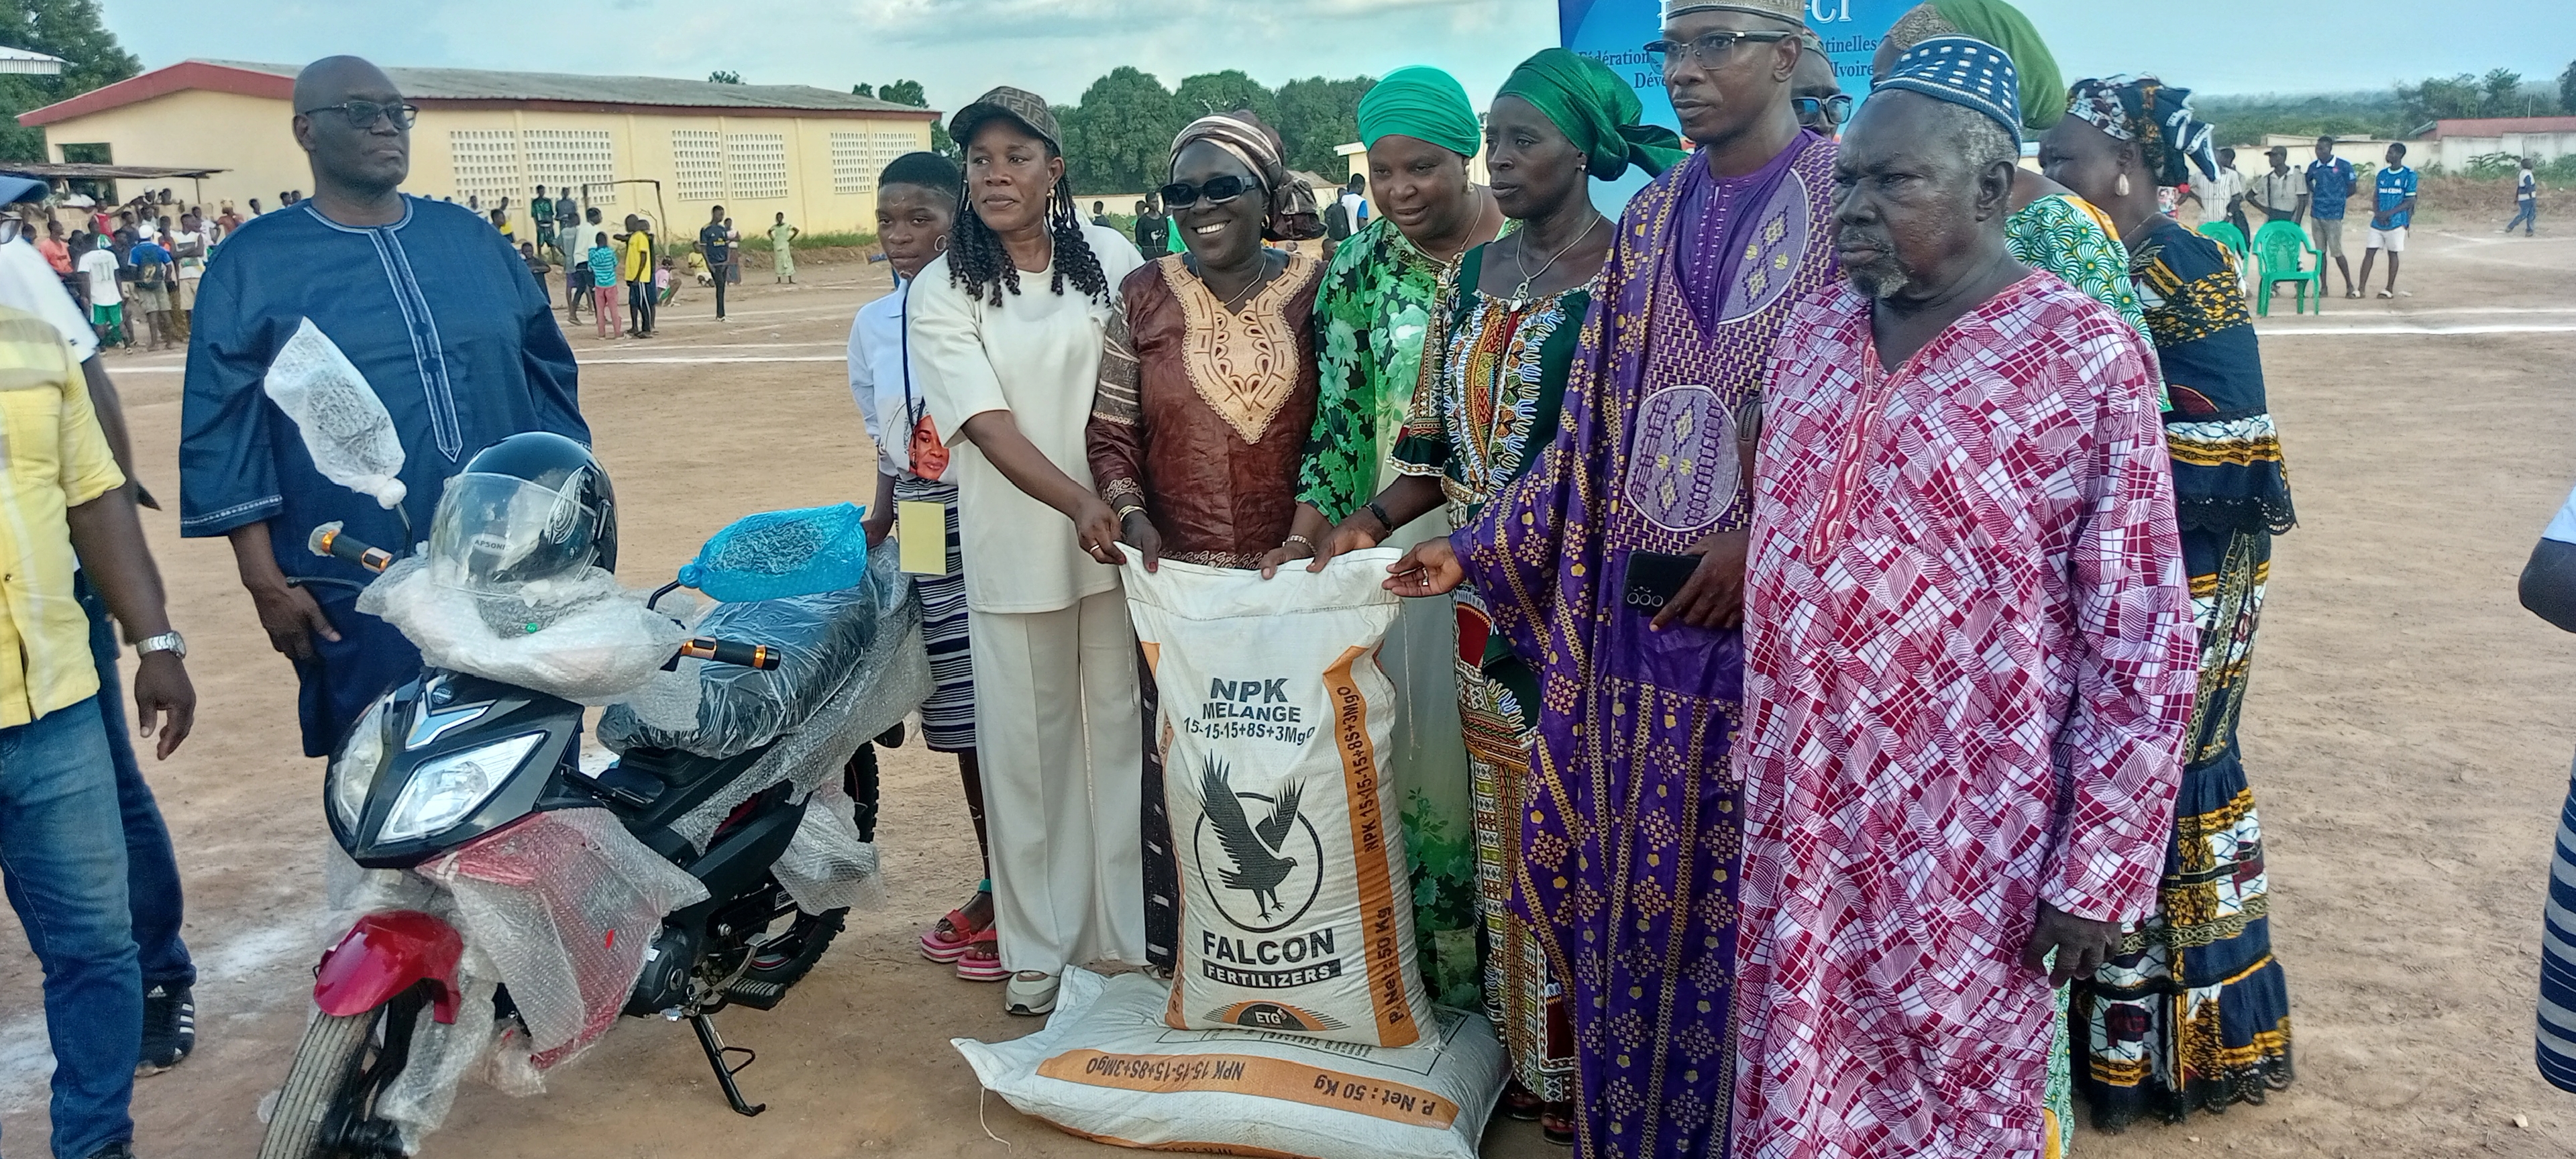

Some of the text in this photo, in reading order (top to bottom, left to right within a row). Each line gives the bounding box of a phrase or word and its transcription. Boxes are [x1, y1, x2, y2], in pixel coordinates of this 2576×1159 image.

[1210, 677, 1289, 704] NPK
[1202, 702, 1301, 723] MELANGE
[1362, 821, 1379, 853] NPK
[1375, 906, 1392, 934] Kg
[1203, 928, 1335, 965] FALCON
[1377, 936, 1393, 960] 50
[1208, 964, 1331, 987] FERTILIZERS
[1254, 1011, 1281, 1025] ETG
[1212, 1060, 1245, 1081] NPK
[1313, 1074, 1340, 1096] Kg
[1343, 1083, 1366, 1101] 50
[1382, 1089, 1416, 1112] Net
[1421, 1099, 1436, 1116] P.
